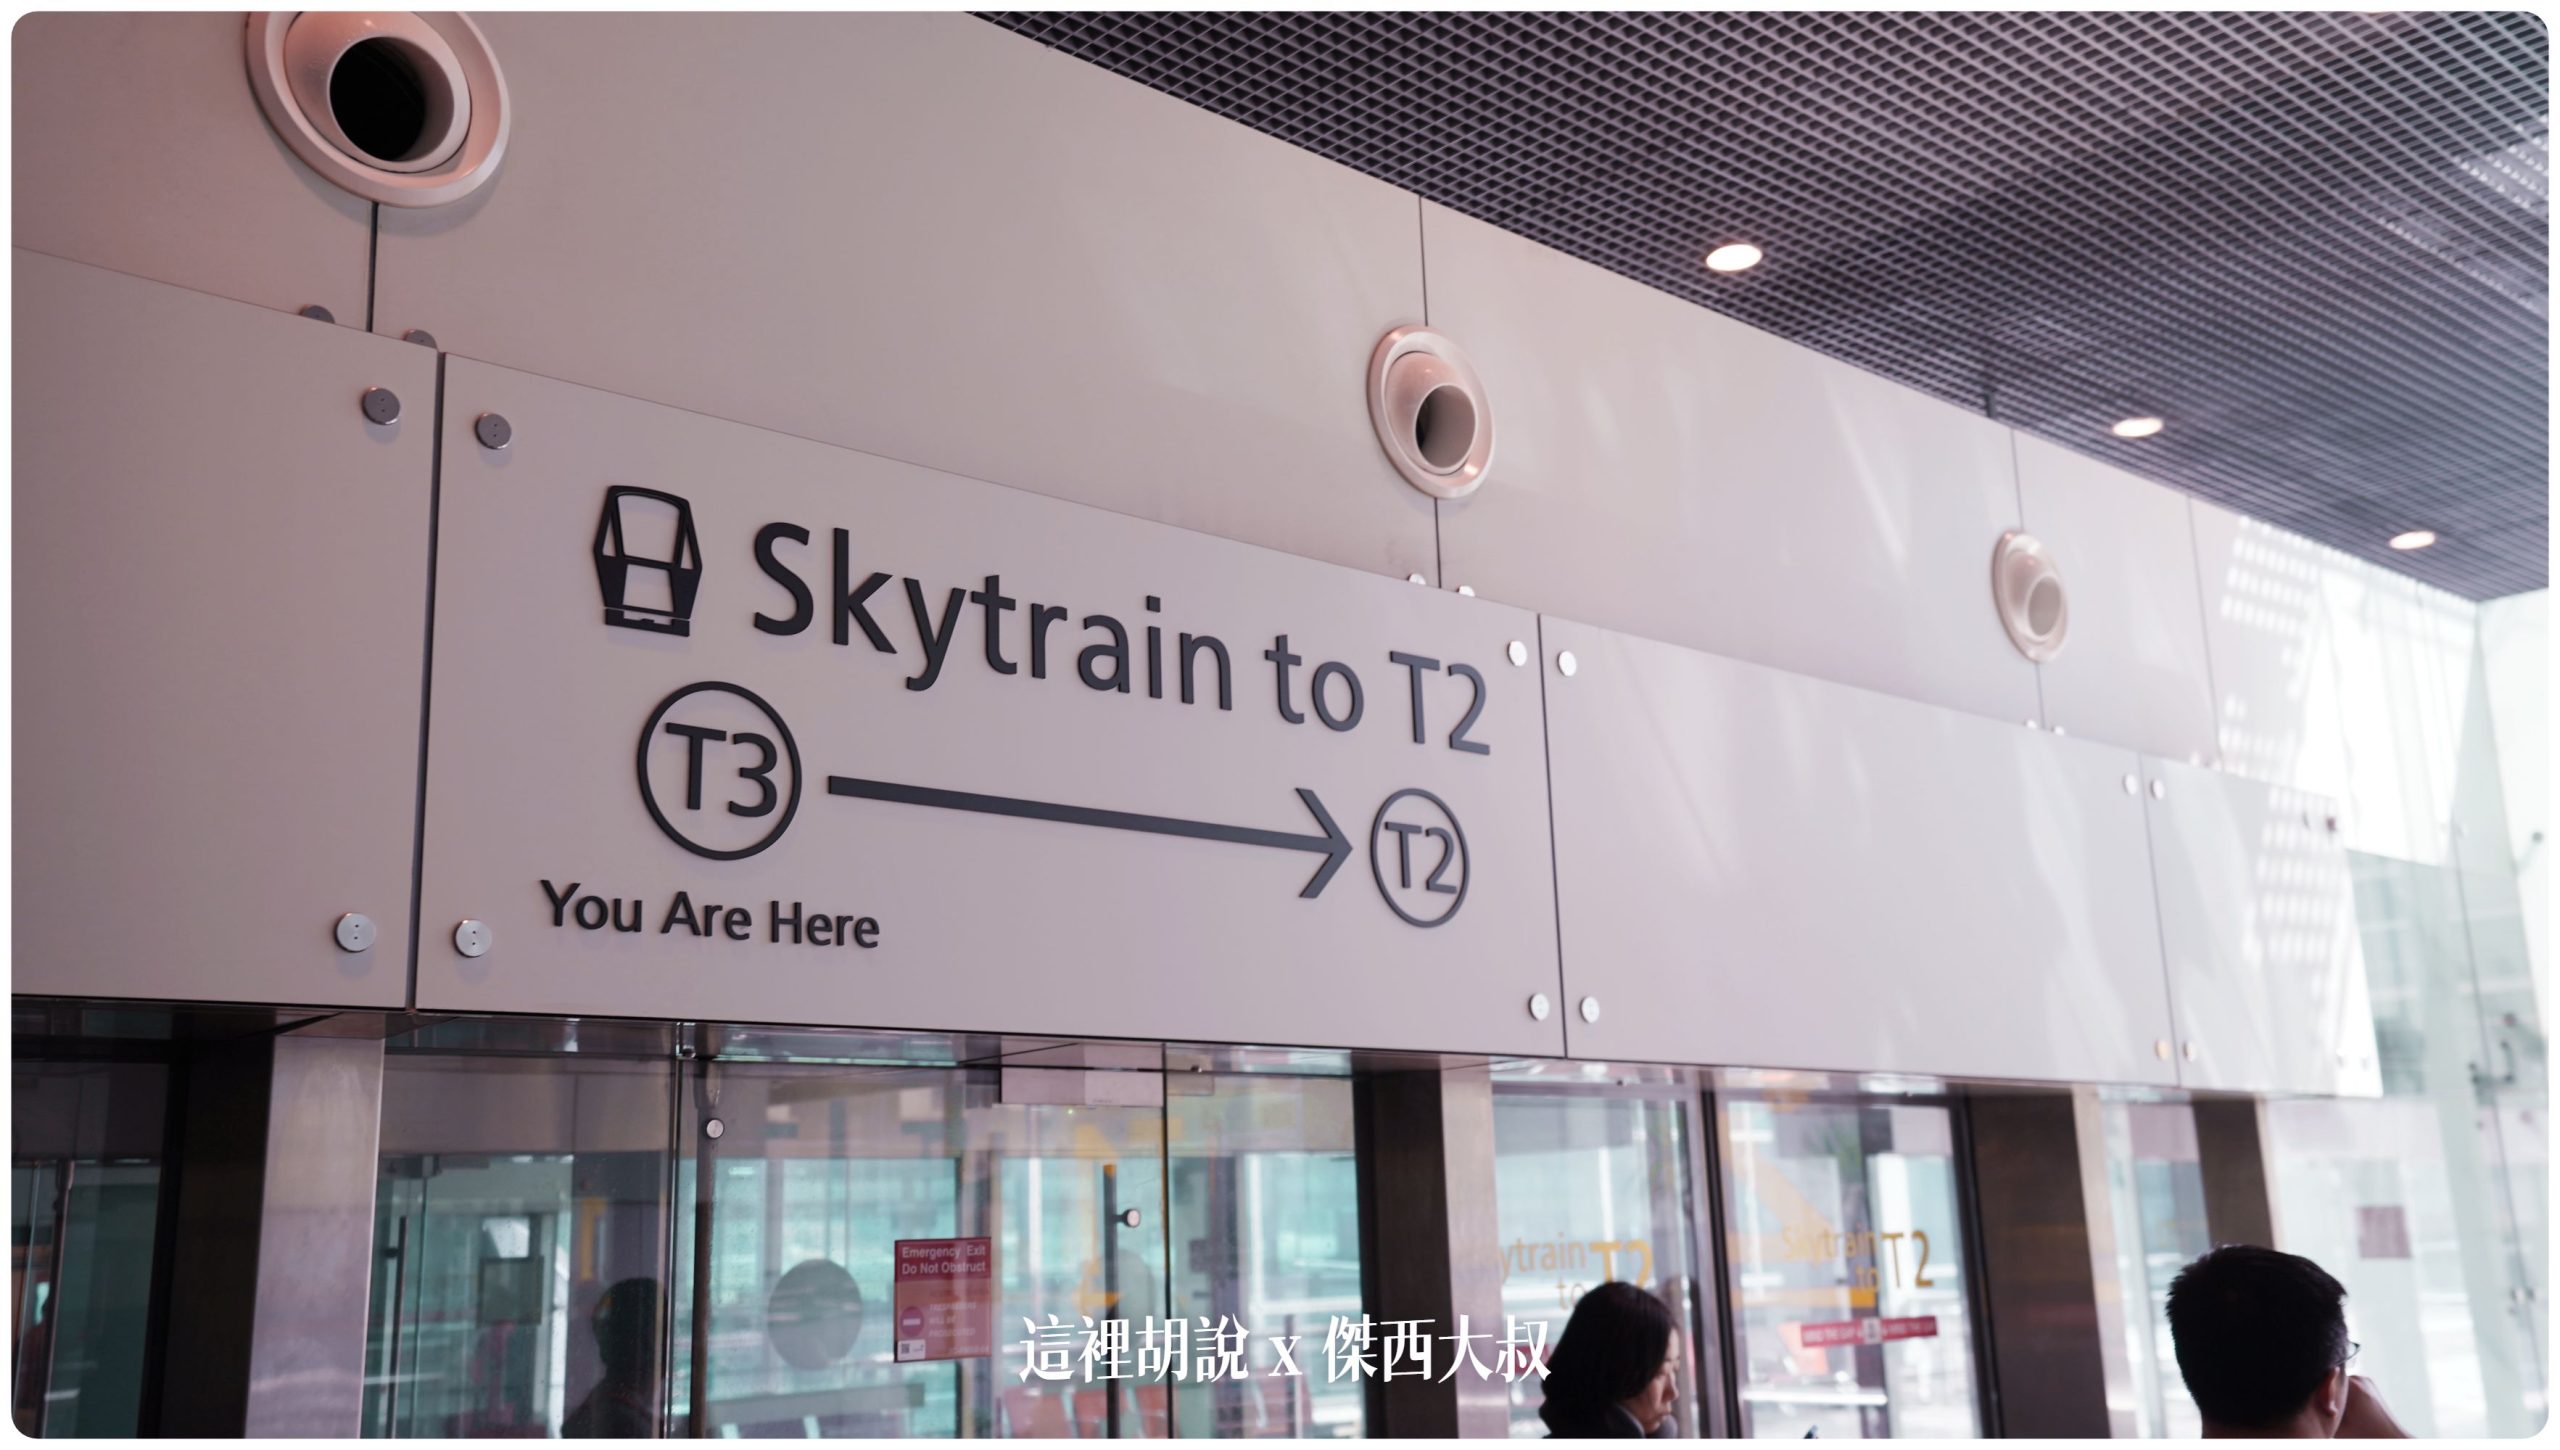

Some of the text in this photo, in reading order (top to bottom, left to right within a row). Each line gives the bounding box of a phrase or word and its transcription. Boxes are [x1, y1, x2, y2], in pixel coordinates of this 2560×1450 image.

[752, 521, 1491, 756] Skytrain to T2
[663, 721, 779, 818] T3
[1384, 820, 1458, 895] T2
[539, 879, 881, 949] You Are Here
[902, 1244, 986, 1260] Emergency Exit
[902, 1261, 986, 1275] Do Not Obstruct
[1500, 1231, 1586, 1288] ytrain
[1783, 1221, 1935, 1288] Skytrain T2
[1855, 1265, 1880, 1293] to
